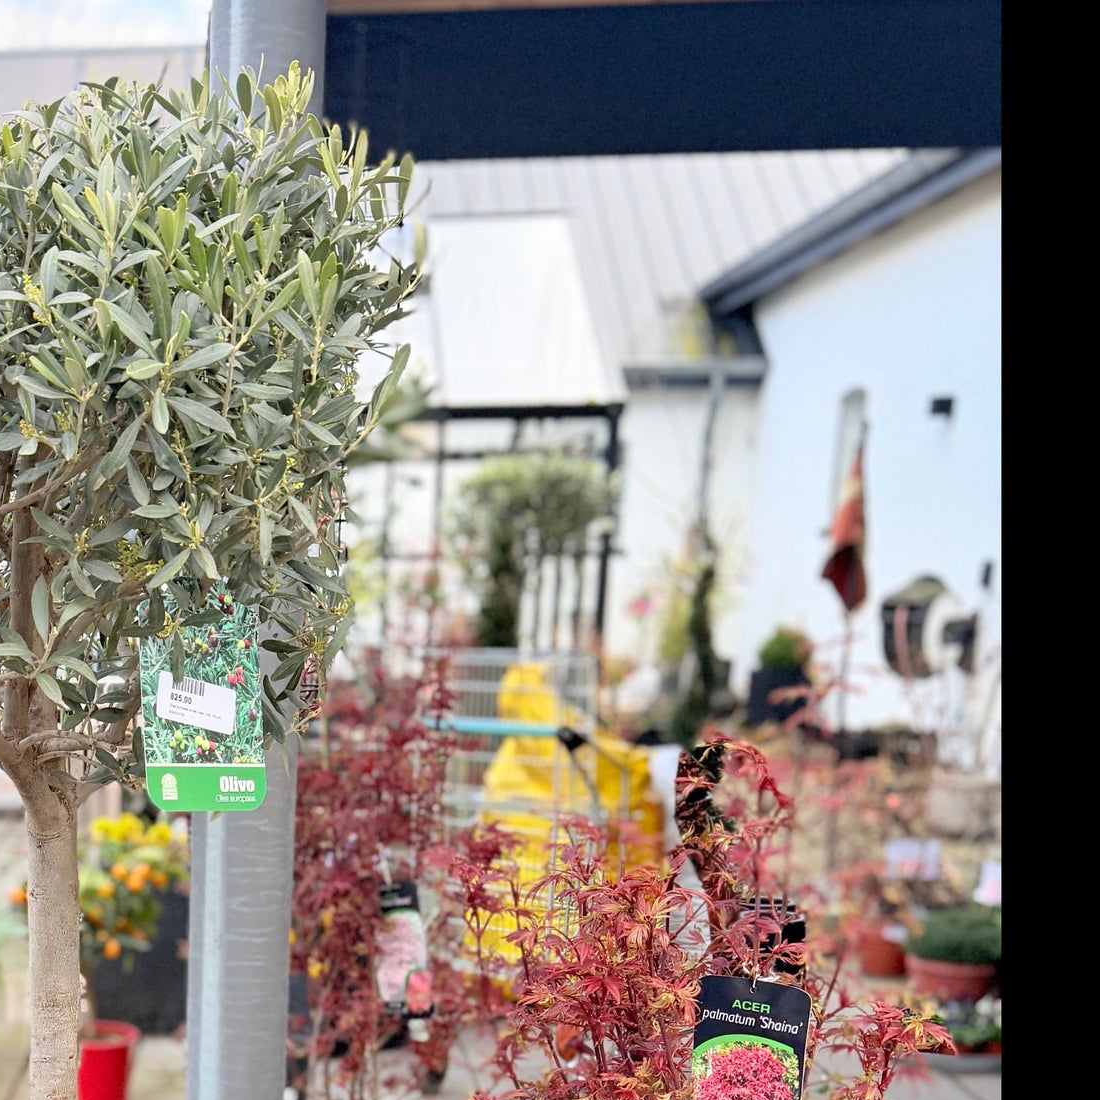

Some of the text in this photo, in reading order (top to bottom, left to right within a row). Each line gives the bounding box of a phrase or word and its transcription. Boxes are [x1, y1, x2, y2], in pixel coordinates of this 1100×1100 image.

[219, 775, 255, 792] Olivo
[732, 999, 771, 1014] ACER
[702, 1009, 756, 1027] palmatum
